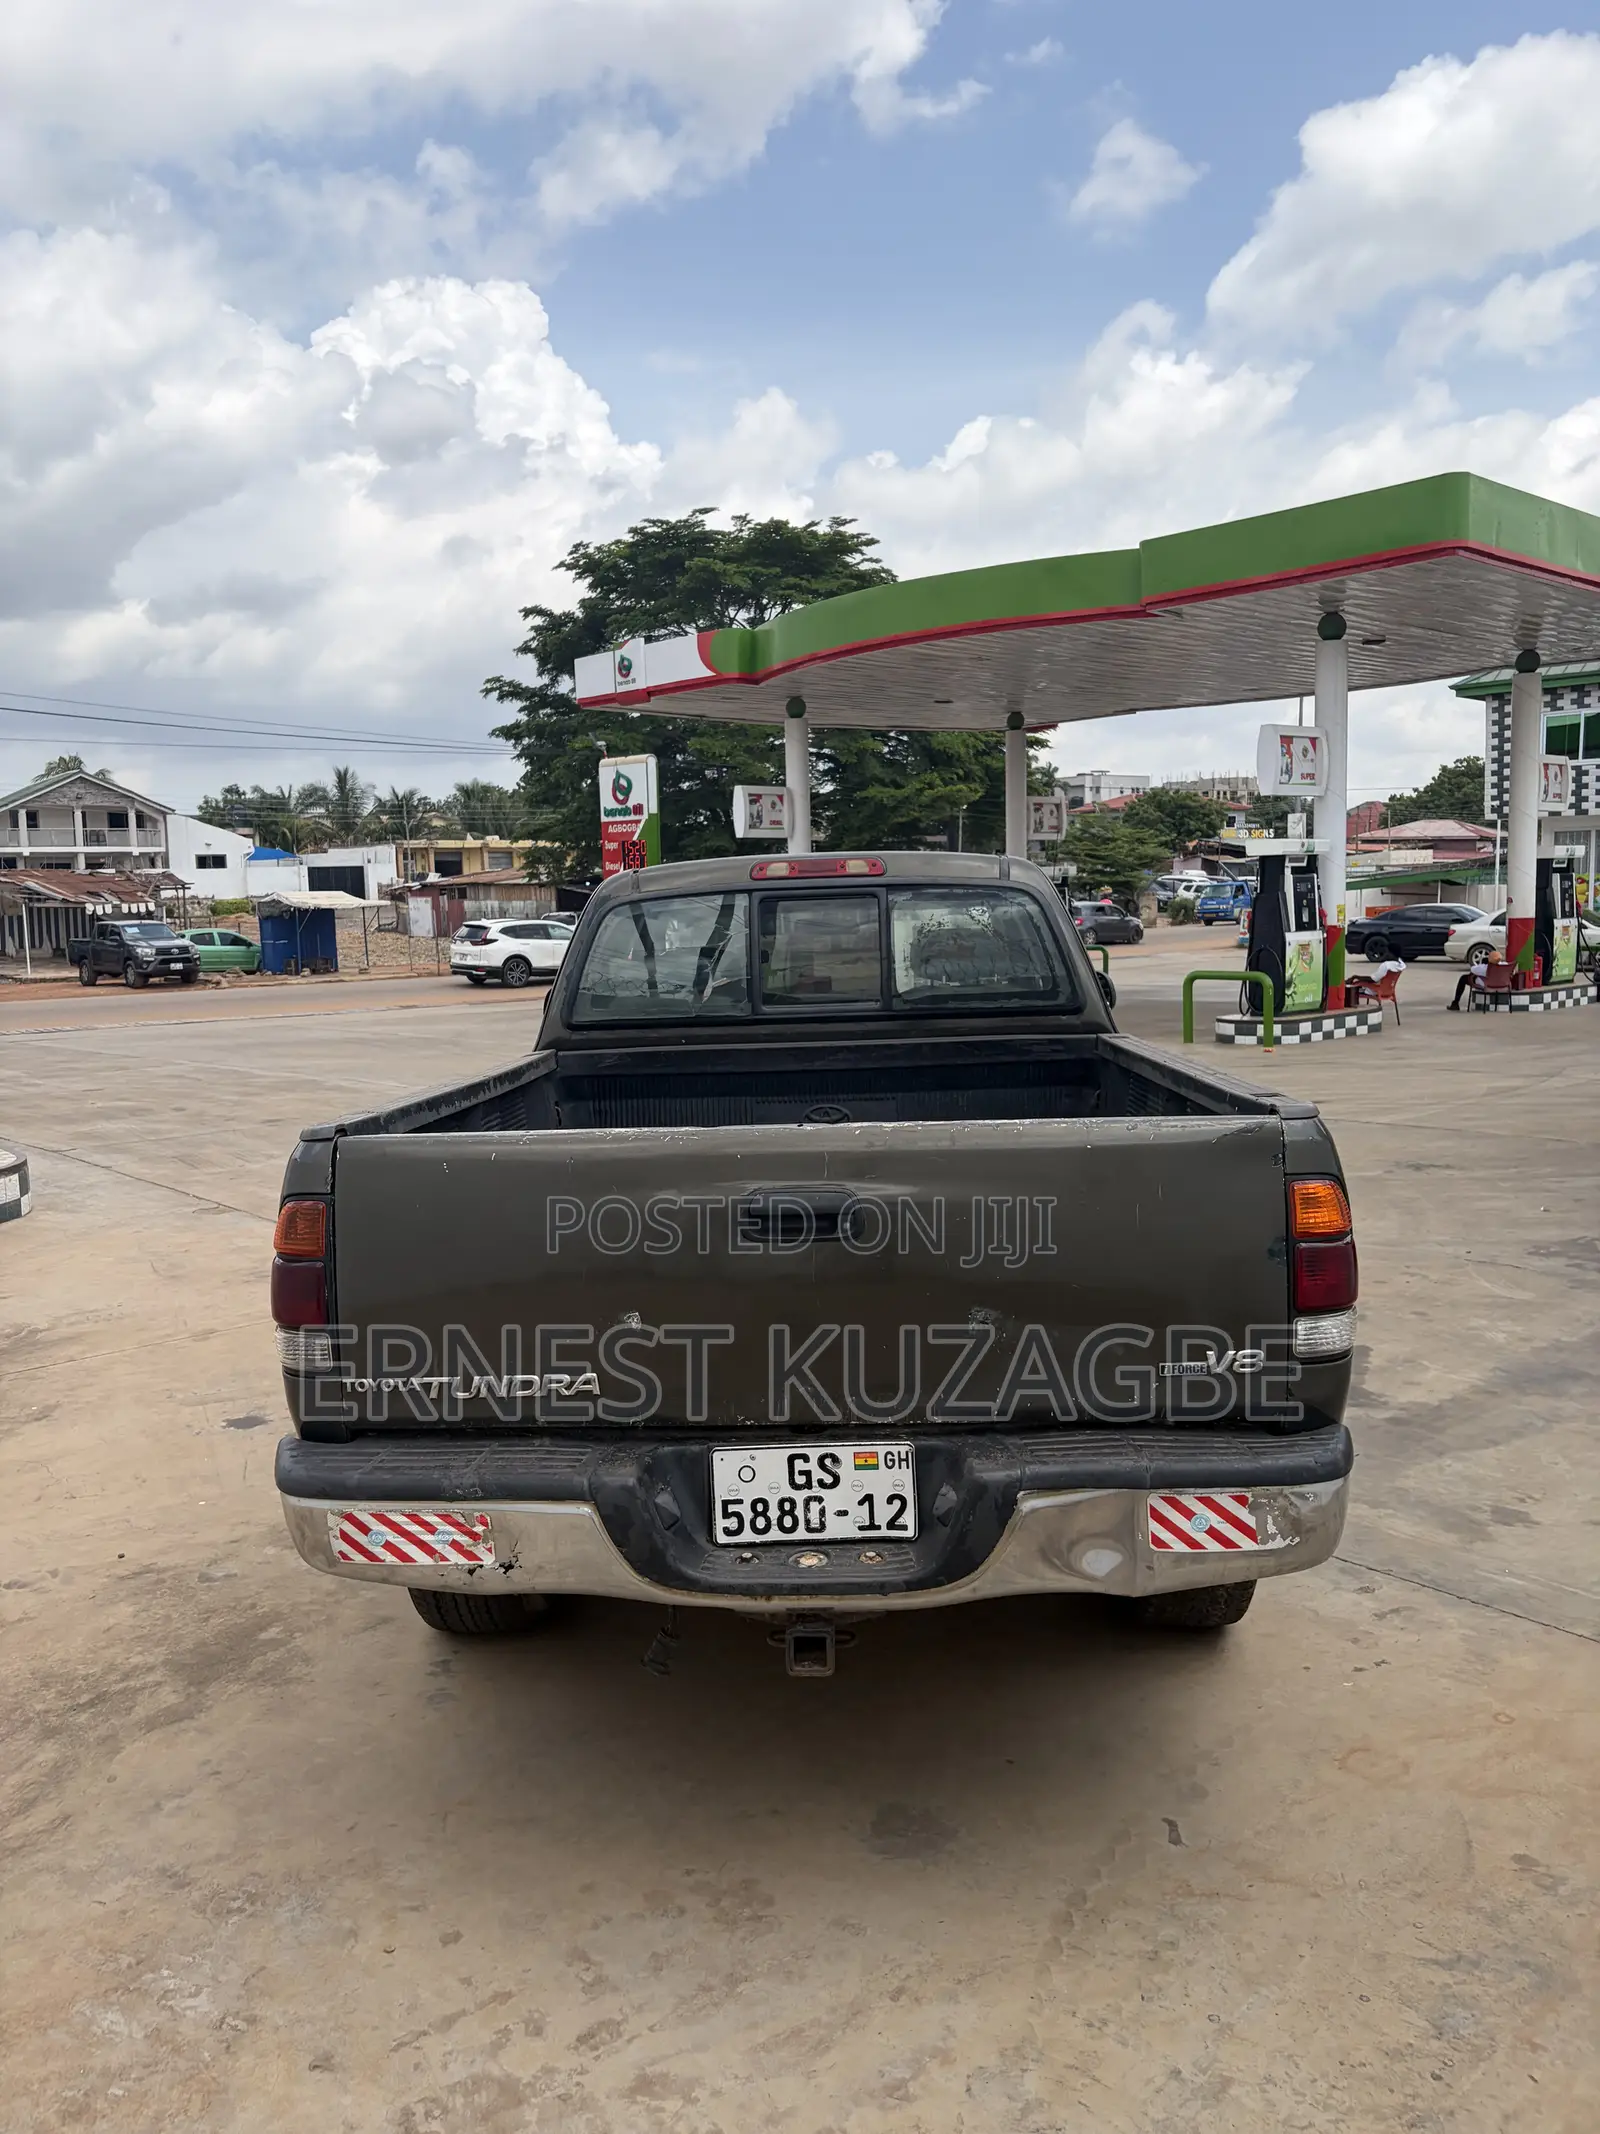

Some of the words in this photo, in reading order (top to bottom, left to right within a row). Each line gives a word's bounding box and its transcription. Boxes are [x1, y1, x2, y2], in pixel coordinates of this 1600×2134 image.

[1301, 772, 1315, 780] SUPER
[1238, 829, 1249, 838] 3D
[1251, 829, 1275, 838] SIGNS
[604, 840, 619, 851] Super
[605, 861, 620, 871] Diesel
[1305, 993, 1313, 1003] oil
[1171, 1363, 1207, 1375] FORCE
[1206, 1349, 1264, 1374] V8
[342, 1377, 421, 1393] TOYOTA
[418, 1373, 600, 1400] TUNDRA
[884, 1450, 910, 1470] GH
[787, 1452, 842, 1491] GS
[721, 1493, 909, 1537] 5880-12
